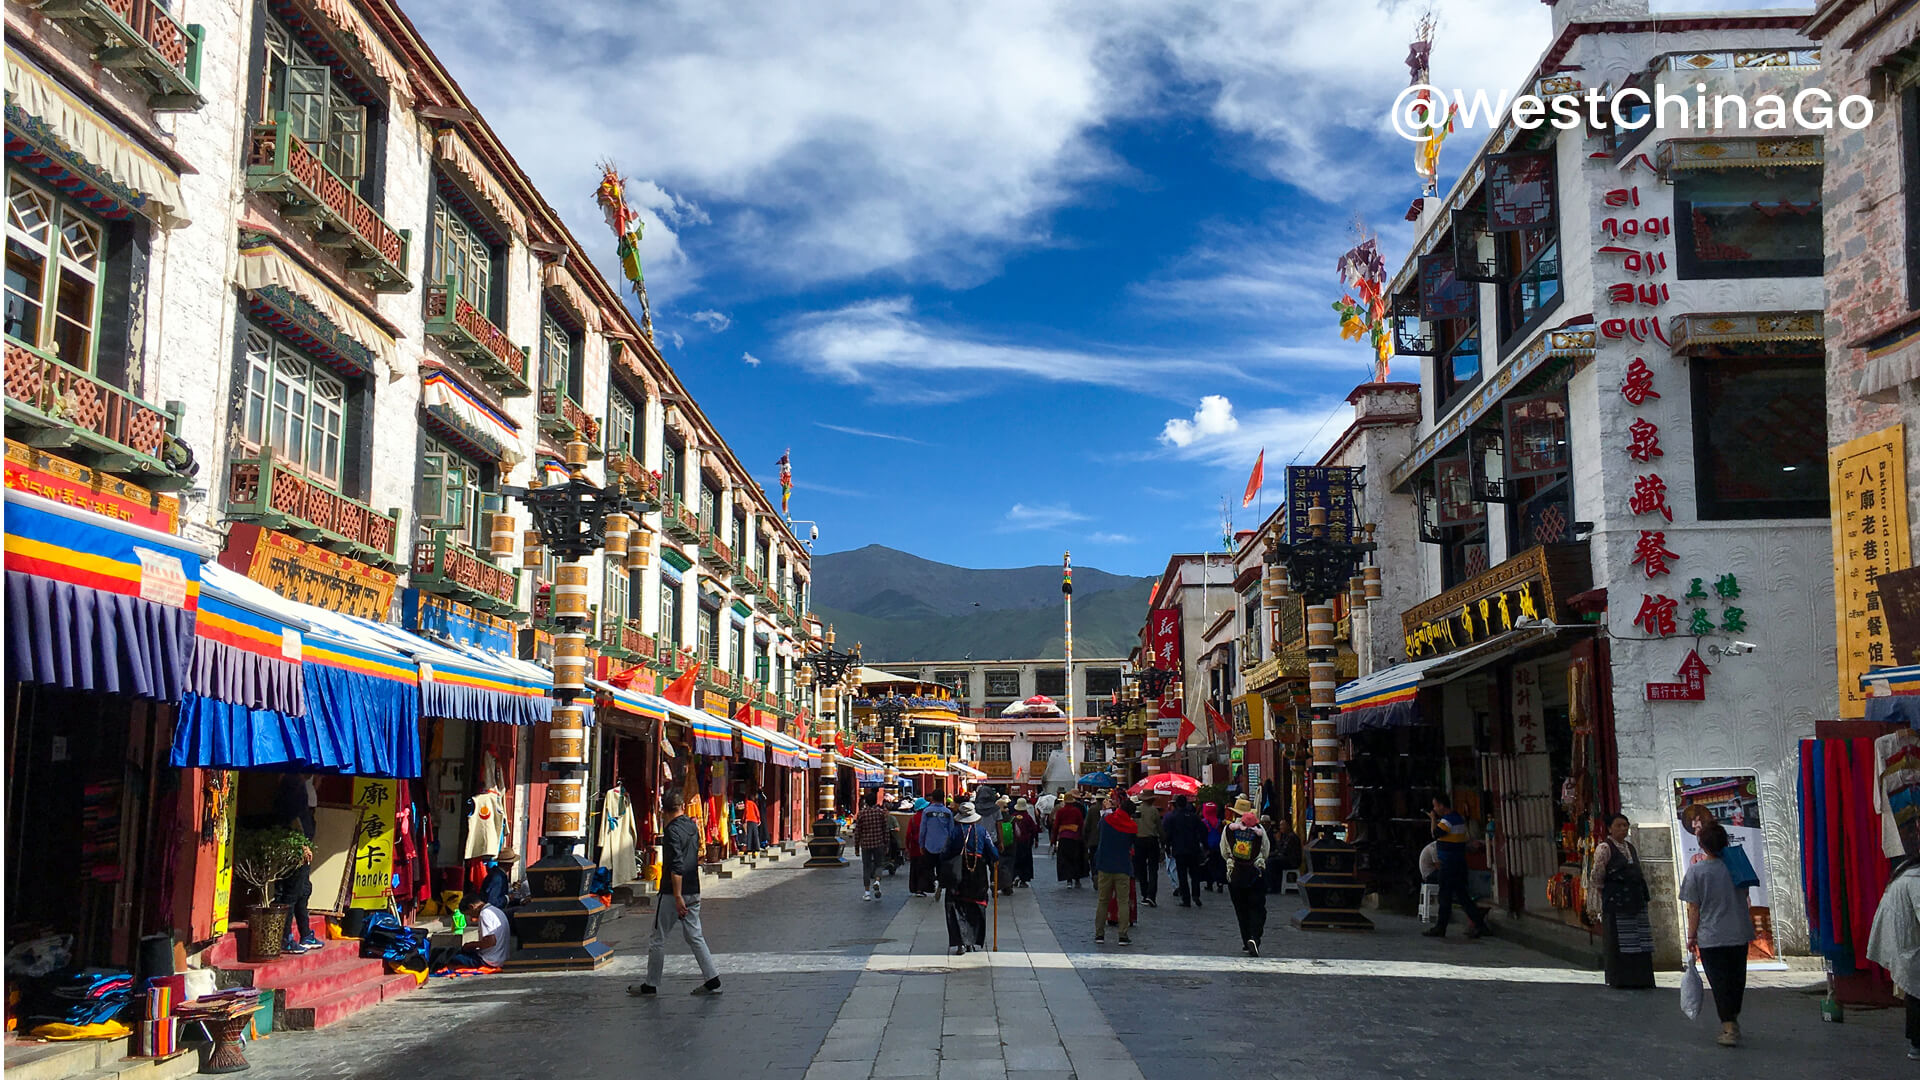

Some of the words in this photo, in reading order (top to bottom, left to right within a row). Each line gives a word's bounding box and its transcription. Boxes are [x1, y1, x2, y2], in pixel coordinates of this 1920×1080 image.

[1621, 357, 1680, 637] 象泉藏餐馆
[1881, 515, 1890, 537] old
[1883, 541, 1891, 574] cone
[1688, 657, 1701, 691] 上楼梯
[1650, 685, 1690, 699] 前行十米
[355, 870, 389, 888] hangka
